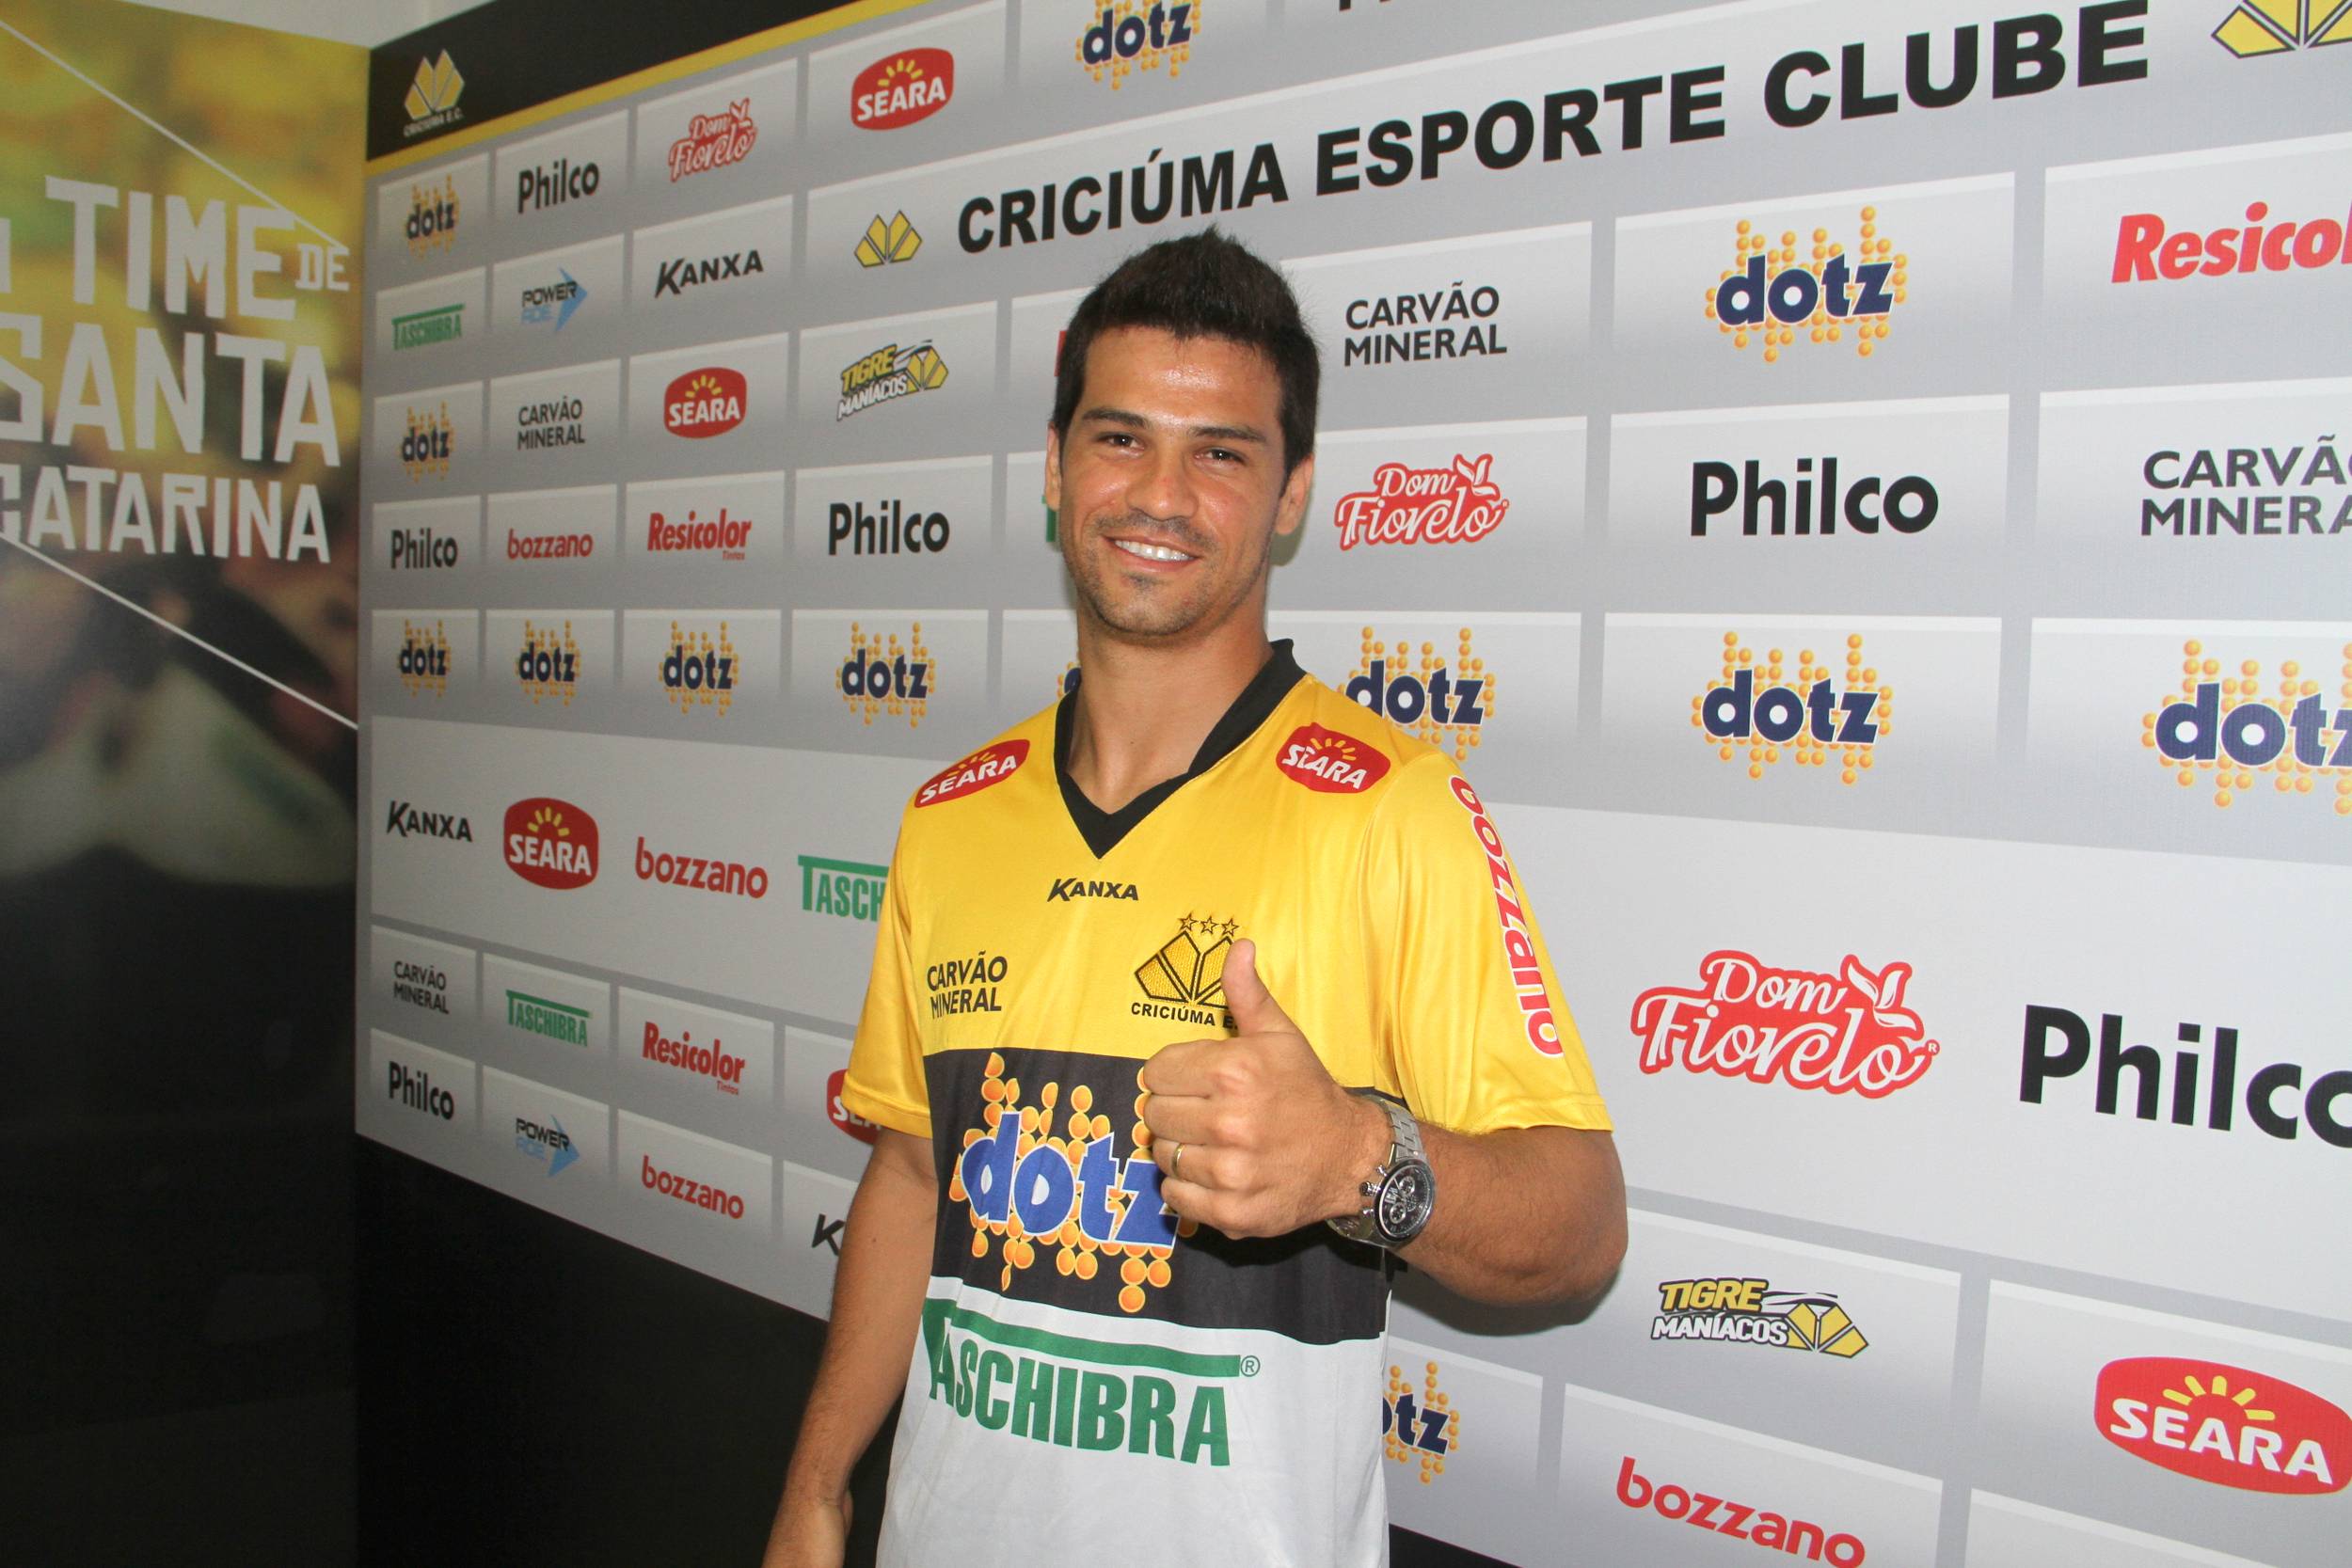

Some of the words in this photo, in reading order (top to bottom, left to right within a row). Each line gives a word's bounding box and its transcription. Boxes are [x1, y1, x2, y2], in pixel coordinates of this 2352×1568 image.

[1084, 4, 1191, 63] dotz
[856, 77, 946, 121] SEARA
[670, 123, 755, 180] Fiorelo
[692, 117, 733, 138] Dom
[958, 144, 1288, 254] CRICIÚMA
[1317, 66, 1724, 196] ESPORTE
[1765, 0, 2148, 127] CLUBE
[518, 160, 598, 214] Philco
[406, 200, 454, 241] dotz
[45, 176, 295, 320] TIME
[295, 242, 350, 292] DE
[523, 280, 578, 307] POWER
[655, 251, 763, 297] KANXA
[1717, 254, 1893, 324] dotz
[1345, 281, 1500, 330] CARVÃO
[841, 344, 897, 394] TIGRE
[1344, 325, 1507, 367] MINERAL
[0, 311, 341, 467] SANTA
[518, 395, 582, 426] CARVÃO
[669, 397, 740, 427] SEARA
[403, 427, 449, 462] dotz
[517, 428, 585, 451] MINERAL
[2144, 435, 2352, 489] CARVÃ
[1379, 467, 1455, 497] Dom
[1692, 458, 1938, 536] Philco
[648, 510, 752, 550] Resicolor
[829, 500, 949, 555] Philco
[1340, 486, 1502, 546] Fiorelo
[2142, 487, 2352, 535] MINERA
[391, 529, 457, 569] Philco
[508, 532, 593, 560] bozzano
[400, 640, 446, 676] dotz
[518, 642, 575, 682] dotz
[663, 645, 732, 689] dotz
[843, 649, 925, 697] dotz
[1347, 660, 1483, 723] dotz
[1704, 670, 1878, 743] dotz
[920, 754, 1017, 804] SEARA
[387, 801, 471, 842] KANXA
[509, 834, 593, 876] SEARA
[636, 837, 768, 897] bozzano
[797, 855, 888, 922] TASCH
[1047, 879, 1138, 902] KANXA
[1452, 778, 1563, 1053] bozzano
[393, 961, 447, 990] CARVÃO
[928, 950, 1008, 991] CARVÃO
[1707, 958, 1849, 1014] Dom
[393, 985, 450, 1014] MINERAL
[505, 990, 589, 1044] TASCHIBRA
[930, 988, 1002, 1019] MINERAL
[1131, 1002, 1216, 1026] CRICIÚMA
[644, 1023, 745, 1084] Resicolor
[1638, 994, 1927, 1091] Fiorelo
[389, 1061, 453, 1120] Philco
[2020, 1005, 2352, 1148] Philco
[516, 1118, 569, 1151] POWER
[643, 1155, 744, 1219] bozzano
[961, 1111, 1182, 1249] dotz
[1661, 1279, 1768, 1312] TIGRE
[1653, 1313, 1788, 1345] MANÍACOS
[922, 1298, 1241, 1466] TASCHIBRA
[1383, 1395, 1448, 1454] tz
[2110, 1399, 2332, 1484] SEARA
[1617, 1457, 1865, 1568] bozzano
